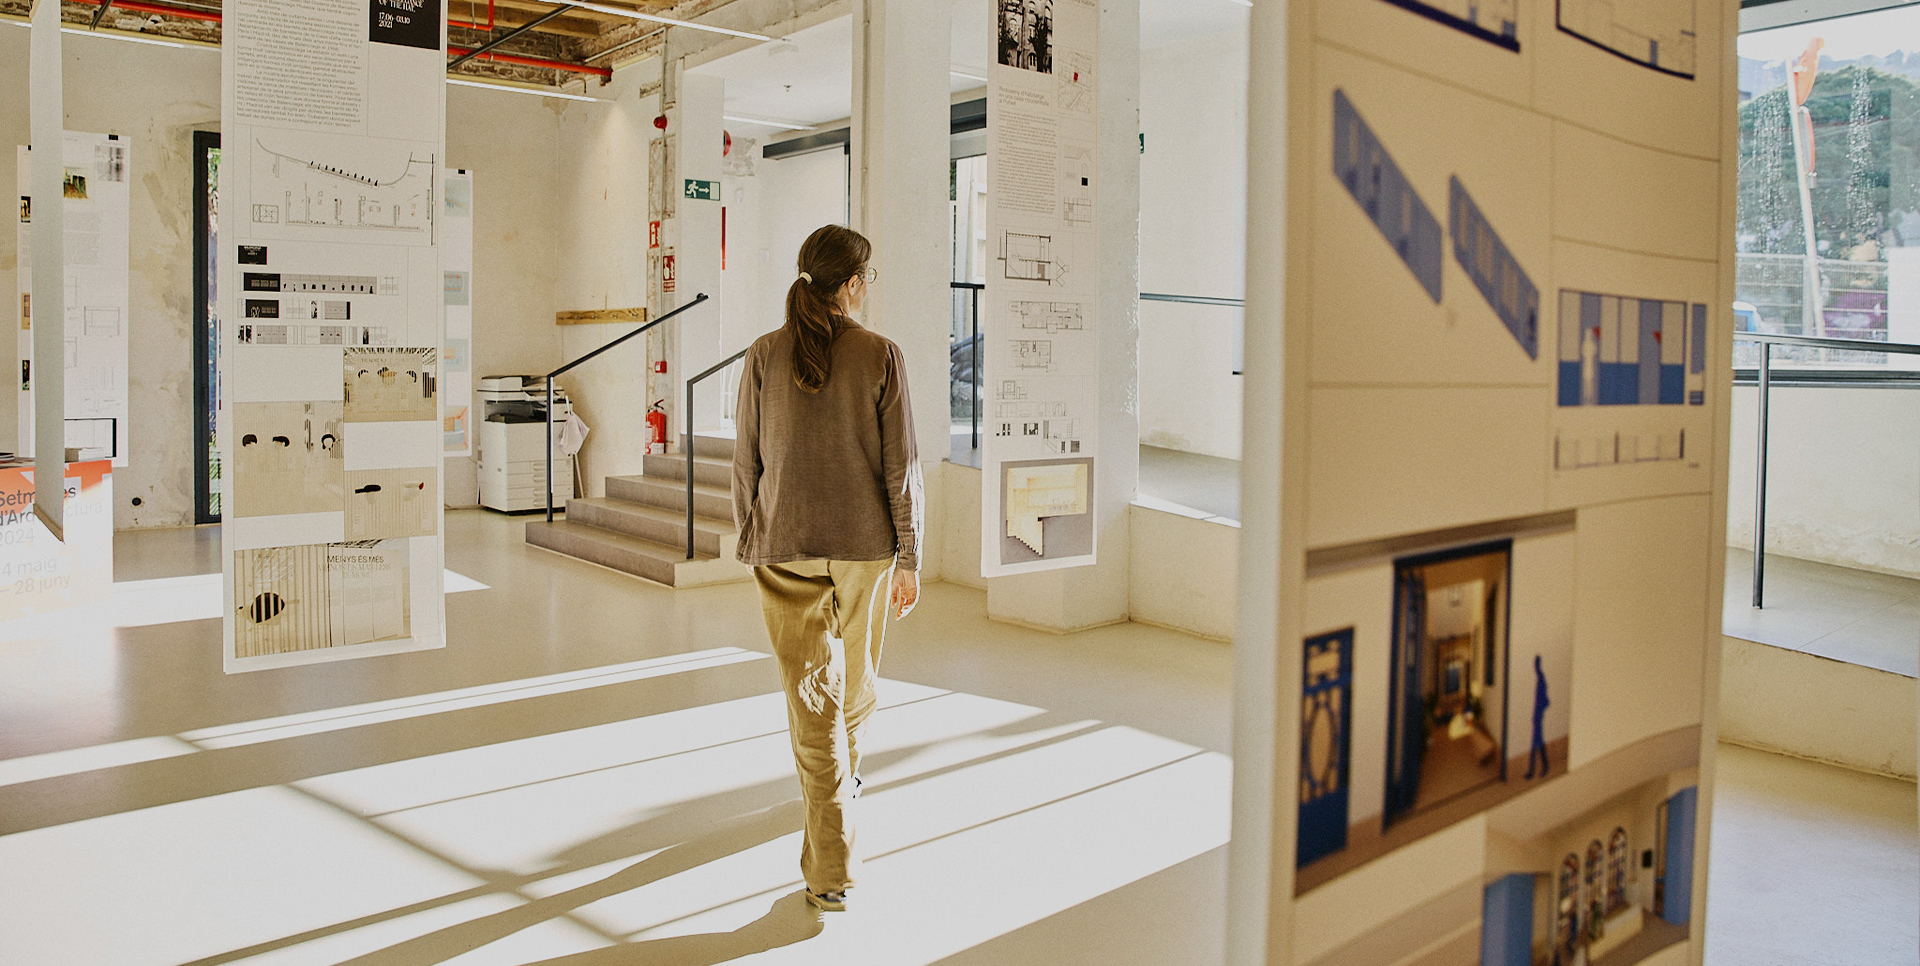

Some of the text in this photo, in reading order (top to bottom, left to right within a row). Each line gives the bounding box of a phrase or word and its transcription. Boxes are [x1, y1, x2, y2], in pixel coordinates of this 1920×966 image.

[378, 20, 392, 28] 2021
[18, 556, 57, 576] maig
[369, 555, 384, 563] MÉS
[15, 578, 34, 595] 28
[40, 575, 70, 593] juny
